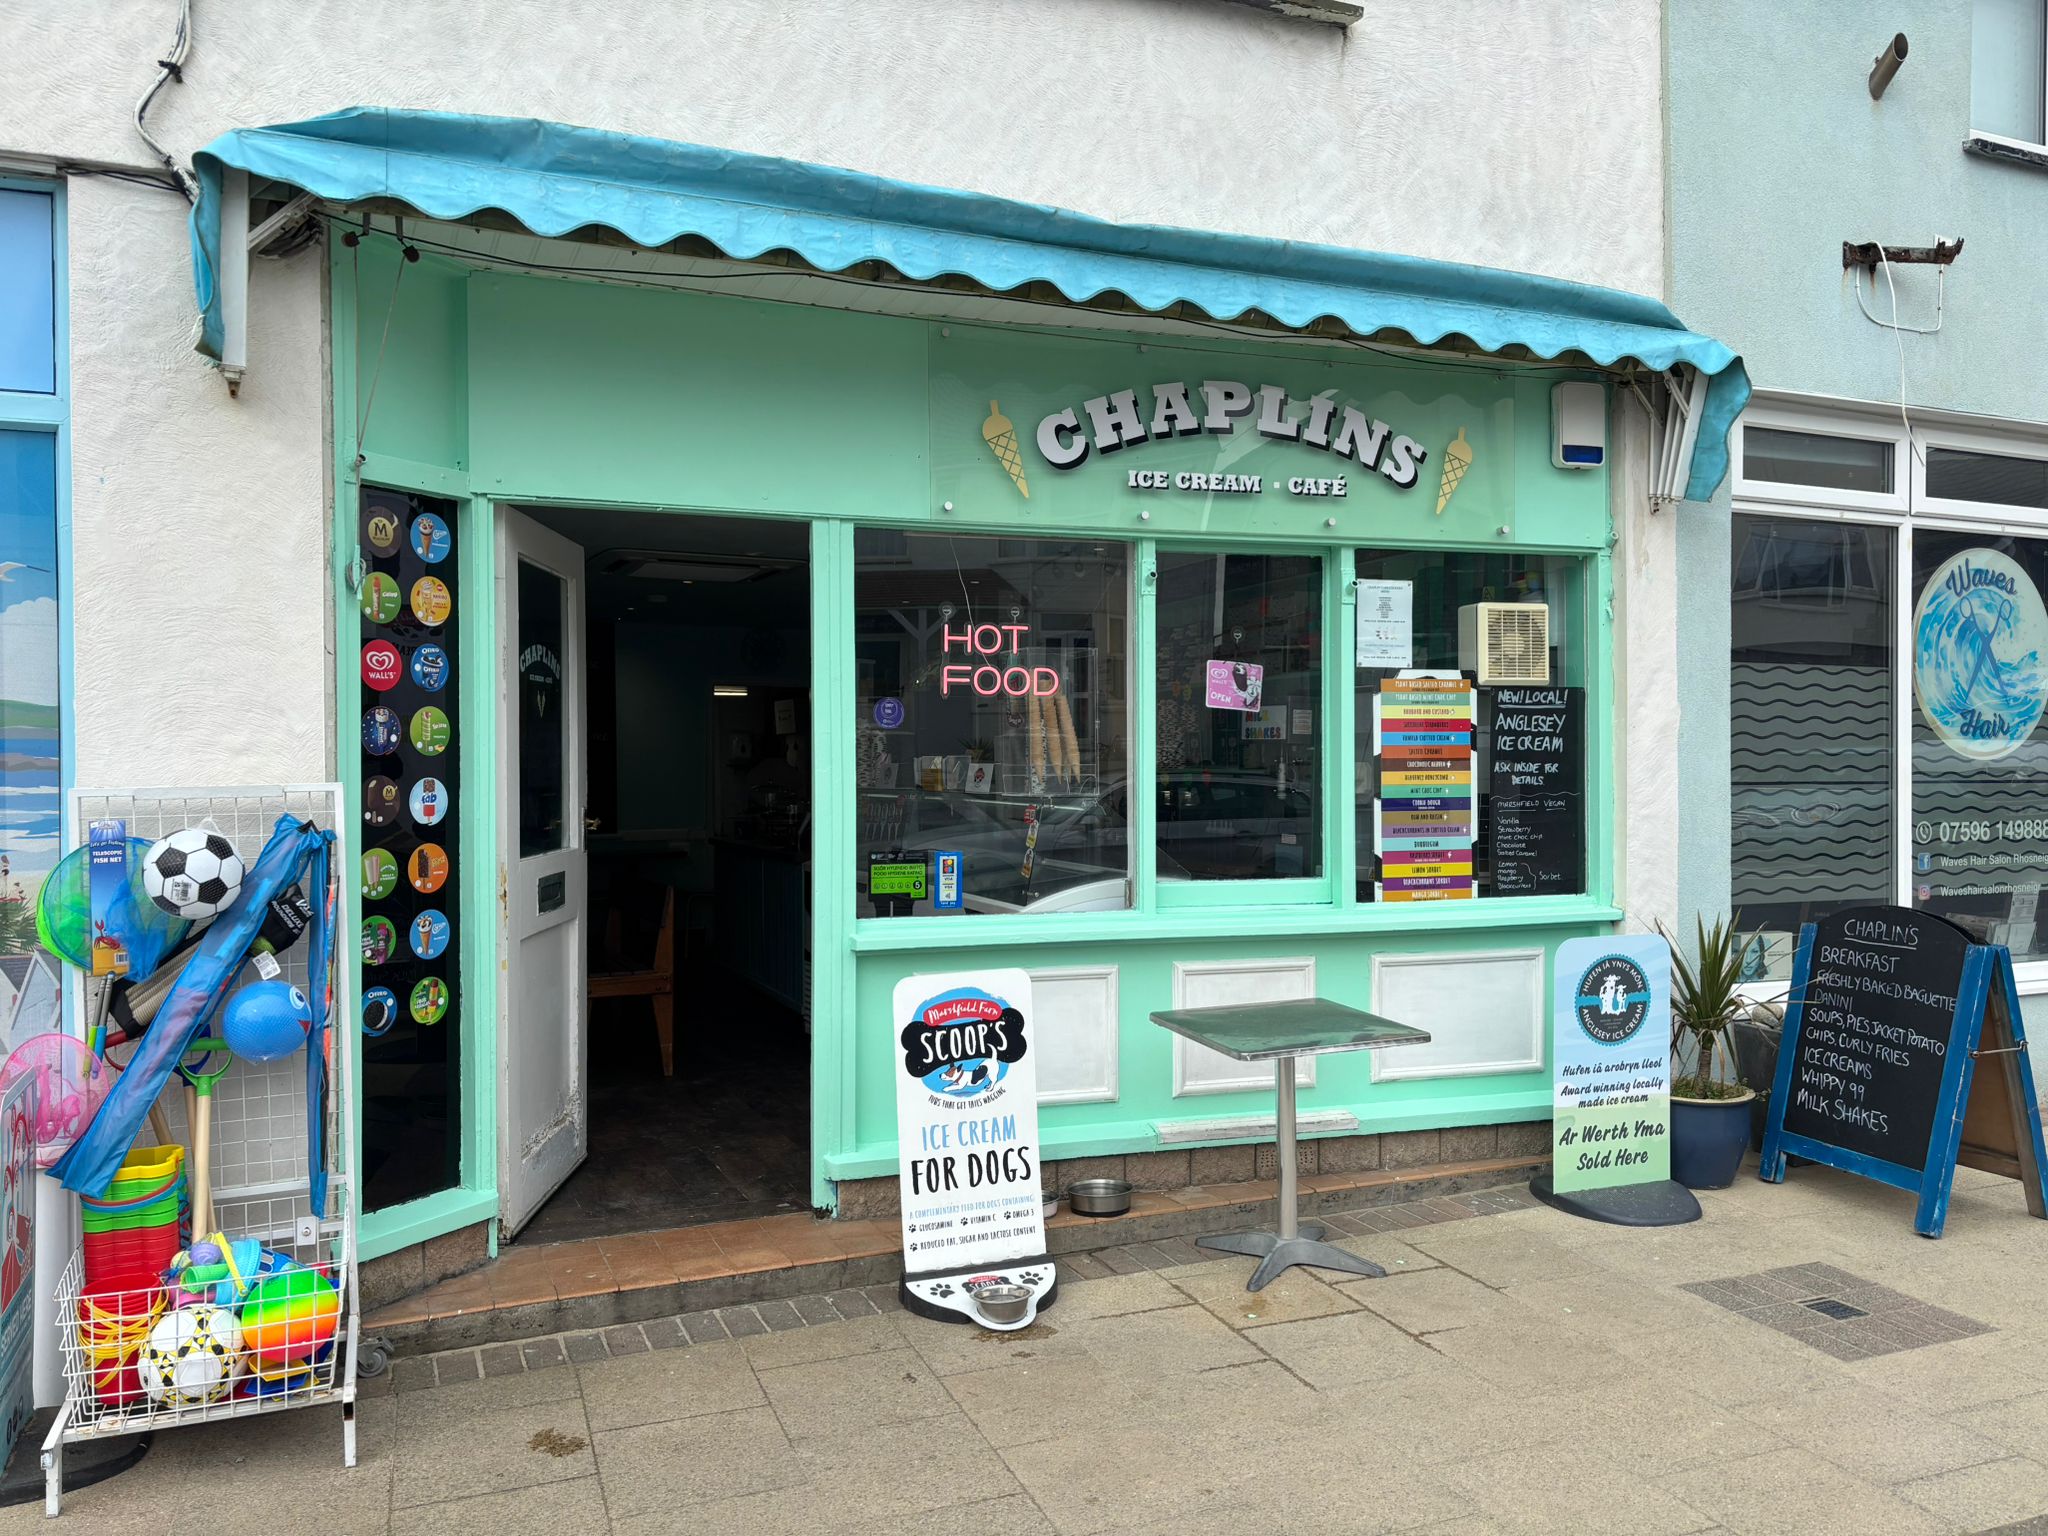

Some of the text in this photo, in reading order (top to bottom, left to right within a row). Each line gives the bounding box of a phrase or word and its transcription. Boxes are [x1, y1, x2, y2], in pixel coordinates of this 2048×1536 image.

[1036, 380, 1427, 490] CHAPLINS
[1128, 470, 1348, 497] ICE CREAM CAFÉ
[1945, 557, 2018, 598] Waves
[942, 623, 1030, 654] HOT
[520, 643, 560, 680] CHAPLINS
[369, 671, 395, 679] WALL'S
[942, 665, 1060, 697] FOOD
[1210, 691, 1232, 703] OPEN
[1497, 688, 1569, 704] NEW! LOCAL!
[1245, 726, 1281, 739] SHAKES
[1495, 712, 1566, 734] ANGLESEY
[1960, 708, 2010, 739] Hair
[1497, 735, 1564, 753] ICE CREAM
[1494, 761, 1559, 774] ASK INSIDE FOR
[1511, 774, 1545, 785] DETAILS
[422, 793, 437, 804] fab
[1543, 799, 1566, 807] VEGAN
[1940, 821, 1991, 842] 07596
[109, 856, 123, 864] NET
[1941, 856, 1968, 867] Waves
[1970, 855, 1987, 866] Hair
[1988, 854, 2012, 865] Salon
[914, 881, 920, 889] 5
[1539, 871, 1561, 881] Sorbet
[1843, 919, 1920, 946] CHAPLIN'S
[1820, 945, 1901, 974] BREAKFAST
[1583, 965, 1602, 992] HUFEN
[1611, 960, 1631, 972] YNYS
[1816, 969, 1861, 991] FRESHLY
[1862, 976, 1903, 999] BAKED
[368, 991, 388, 999] OREO
[927, 1001, 999, 1024] Marshfield Farm
[1582, 1008, 1611, 1040] ANGLESEY
[1612, 1030, 1625, 1040] ICE
[1625, 1004, 1644, 1033] CREAM
[920, 1021, 1008, 1064] SCOOP'S
[1808, 1007, 1846, 1029] SOUPS,
[1870, 1021, 1907, 1044] JACKET
[1907, 1028, 1946, 1056] POTATO
[1838, 1033, 1874, 1055] CURLY
[1875, 1045, 1911, 1067] FRIES
[1562, 1057, 1663, 1077] Hufen iâ arobryn lleol
[1804, 1046, 1873, 1081] ICE CREAMS
[1560, 1076, 1664, 1097] Award winning locally
[1801, 1066, 1866, 1102] WHIPPY 99
[942, 1098, 955, 1110] THAT
[956, 1099, 967, 1110] GET
[968, 1098, 983, 1109] TAILS
[983, 1085, 1006, 1105] WAGGING
[1578, 1093, 1649, 1109] made ice cream
[1796, 1087, 1831, 1116] MILK
[922, 1113, 1017, 1152] ICE CREAM
[1559, 1120, 1666, 1147] Ar Werth Yma
[911, 1146, 1032, 1196] FOR DOGS
[1576, 1148, 1649, 1171] Sold Here
[961, 1203, 974, 1213] FEED
[975, 1201, 986, 1210] FOR
[986, 1199, 1001, 1209] DOGS
[1012, 1208, 1035, 1219] OMEGA 3
[919, 1220, 953, 1232] GLUCOSAMINE
[970, 1213, 997, 1225] VITAMIN C
[920, 1239, 945, 1251] REDUCED
[959, 1234, 977, 1245] SUGAR
[977, 1232, 989, 1242] AND
[990, 1228, 1012, 1240] LACTOSE
[1013, 1225, 1036, 1237] CONTENT
